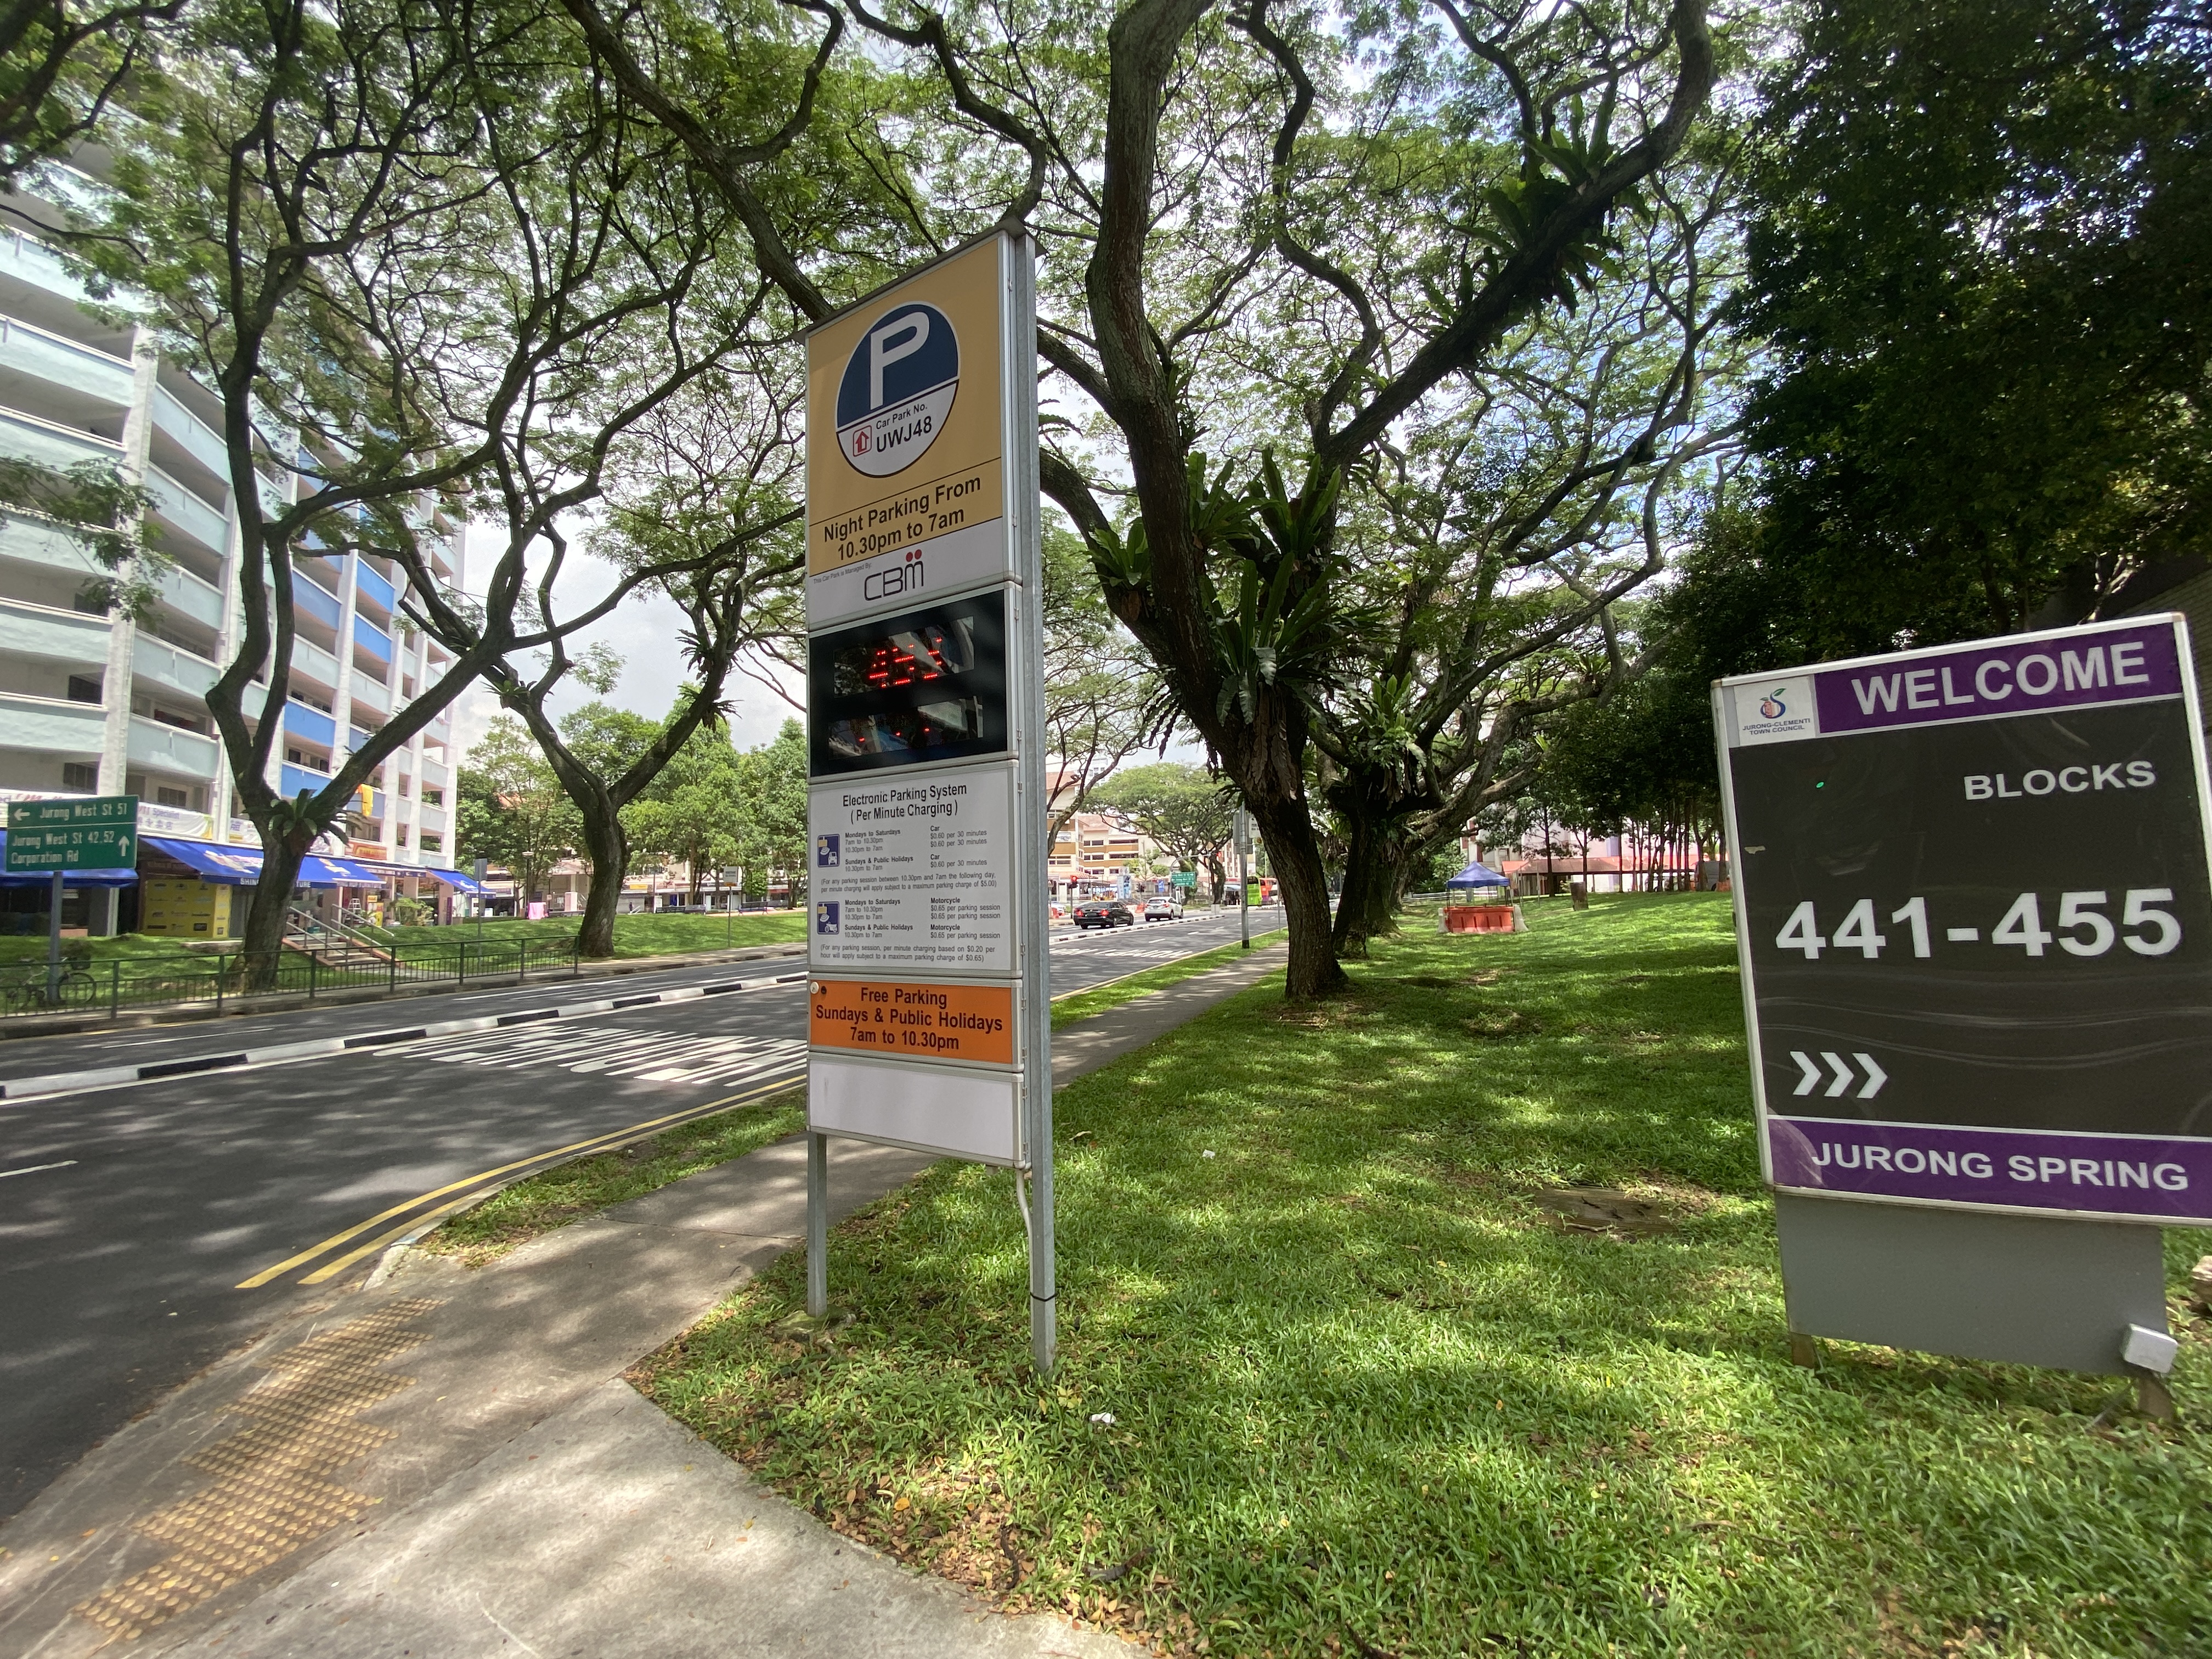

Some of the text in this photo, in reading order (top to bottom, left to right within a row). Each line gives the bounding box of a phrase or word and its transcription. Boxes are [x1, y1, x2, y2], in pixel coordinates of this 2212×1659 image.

[870, 312, 930, 411] P
[877, 403, 928, 430] Car Park No.
[876, 416, 932, 453] UWJ48
[824, 476, 981, 543] Night Parking From
[838, 508, 964, 561] 10.30pm to 7am
[845, 565, 864, 574] Managed
[1850, 641, 2150, 715] WELCOME
[1742, 718, 1810, 731] JURONG-CLEMENTI
[1772, 725, 1804, 733] COUNCIL
[1963, 760, 2156, 800] BLOCKS
[843, 785, 967, 806] Electronic Parking System
[40, 807, 70, 821] Jurong
[75, 804, 97, 817] West
[101, 804, 112, 816] St
[117, 803, 127, 815] 51
[873, 806, 905, 819] Minute
[12, 835, 41, 849] Jurong
[46, 833, 67, 845] West
[72, 832, 82, 844] St
[11, 850, 79, 866] Corporation Rd
[1775, 887, 2182, 960] 441-455
[861, 987, 947, 1009] Free Parking
[816, 1005, 1003, 1034] Sundays & Public Holidays
[850, 1026, 960, 1052] 7am to 10.30pm
[1811, 1141, 2190, 1191] JURONG SPRING
